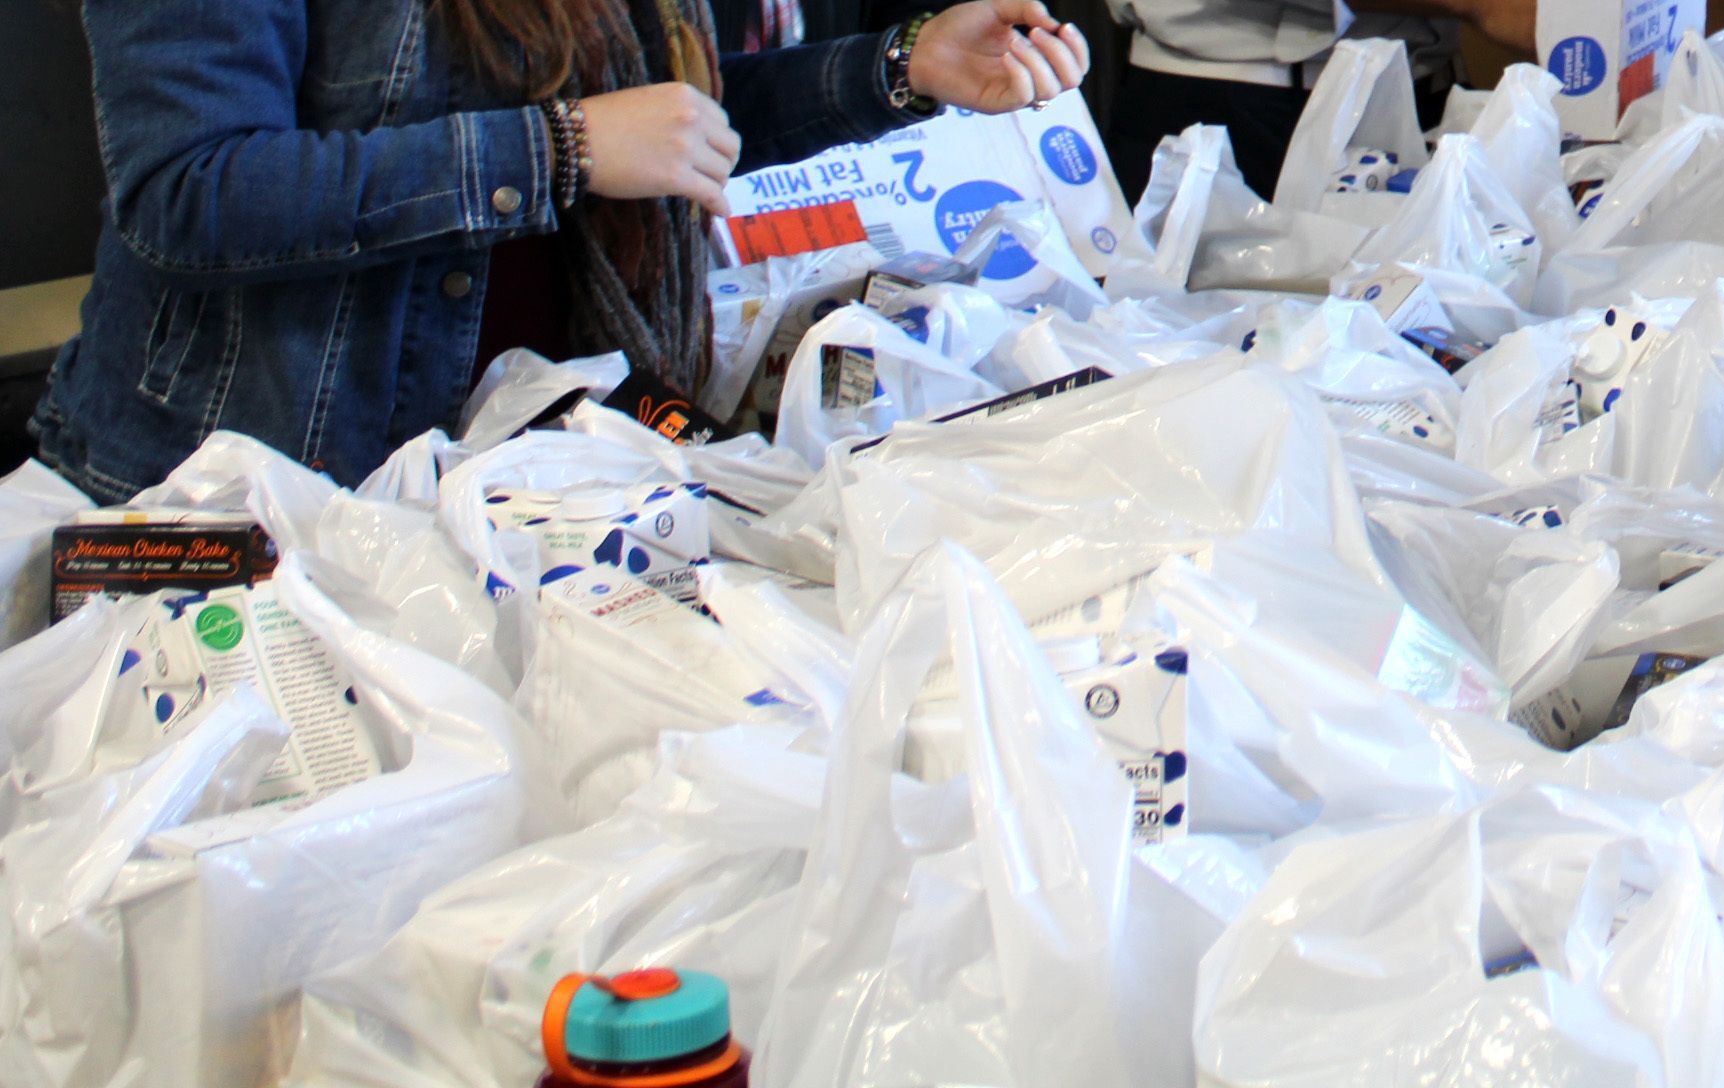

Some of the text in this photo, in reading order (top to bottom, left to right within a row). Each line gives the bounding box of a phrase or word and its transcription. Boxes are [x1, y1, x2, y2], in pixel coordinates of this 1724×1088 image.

[747, 159, 865, 199] Fat Milk
[133, 538, 183, 558] Chicken
[186, 538, 232, 559] Bake
